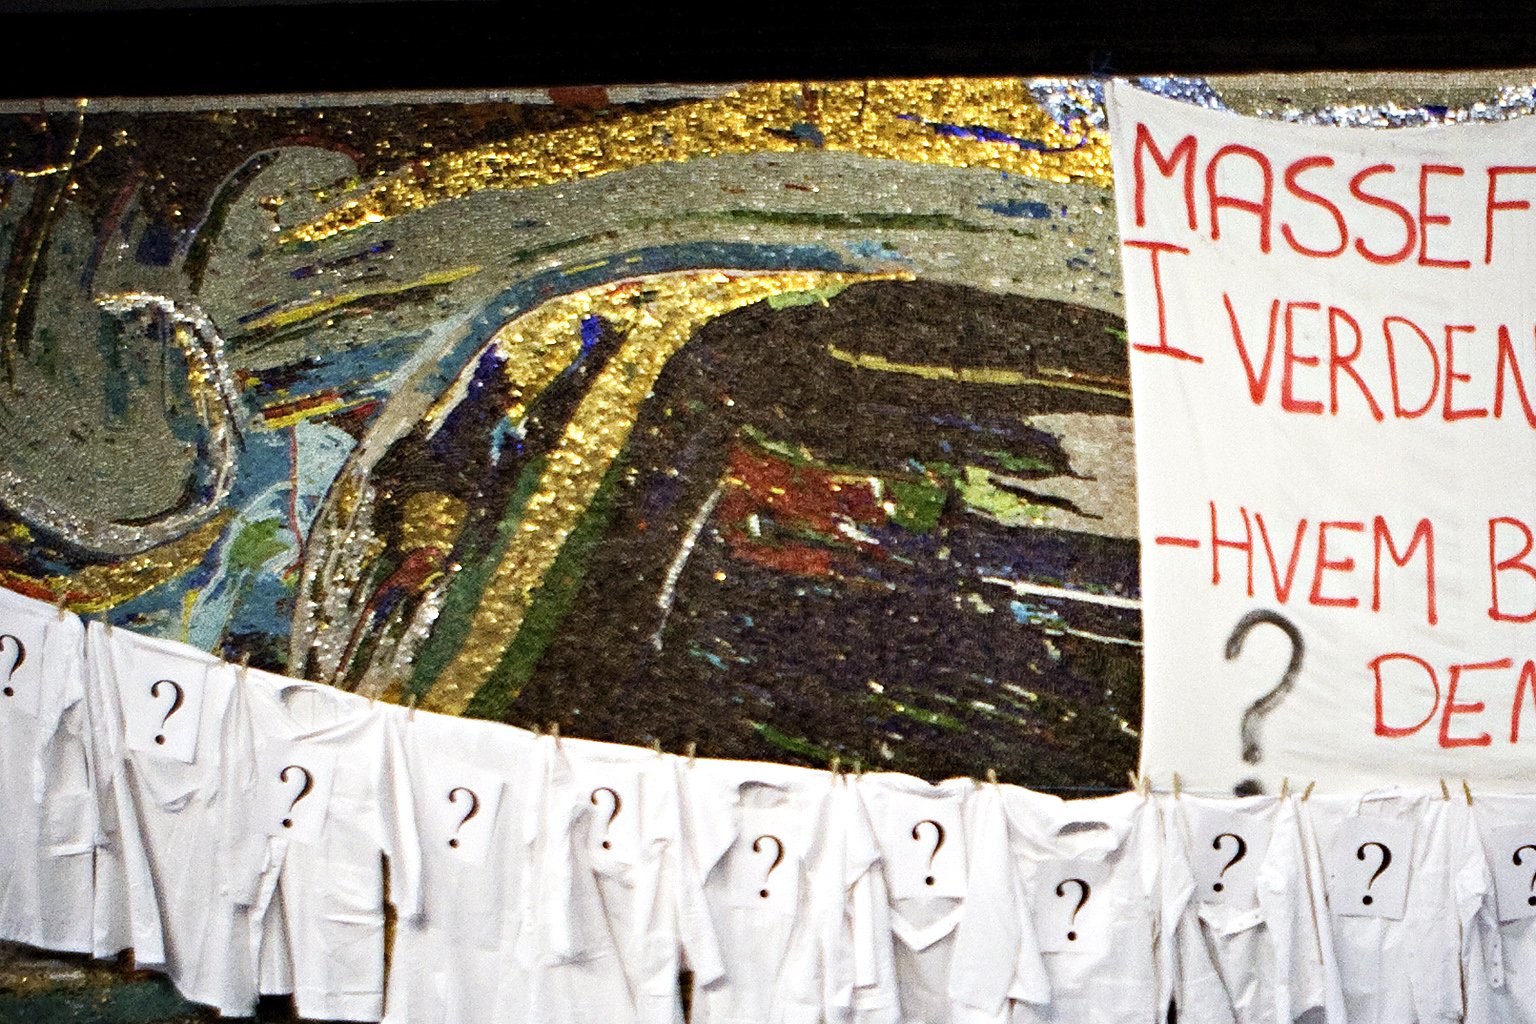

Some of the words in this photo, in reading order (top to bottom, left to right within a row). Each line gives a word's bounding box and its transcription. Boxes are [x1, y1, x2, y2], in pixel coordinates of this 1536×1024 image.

[1123, 239, 1205, 364] I
[150, 679, 185, 745] ?
[279, 765, 314, 829] ?
[447, 787, 481, 849] ?
[590, 787, 622, 850] ?
[752, 834, 785, 899] ?
[911, 819, 946, 886] ?
[1211, 832, 1248, 893] ?
[1356, 841, 1393, 906] ?
[1054, 877, 1091, 942] ?
